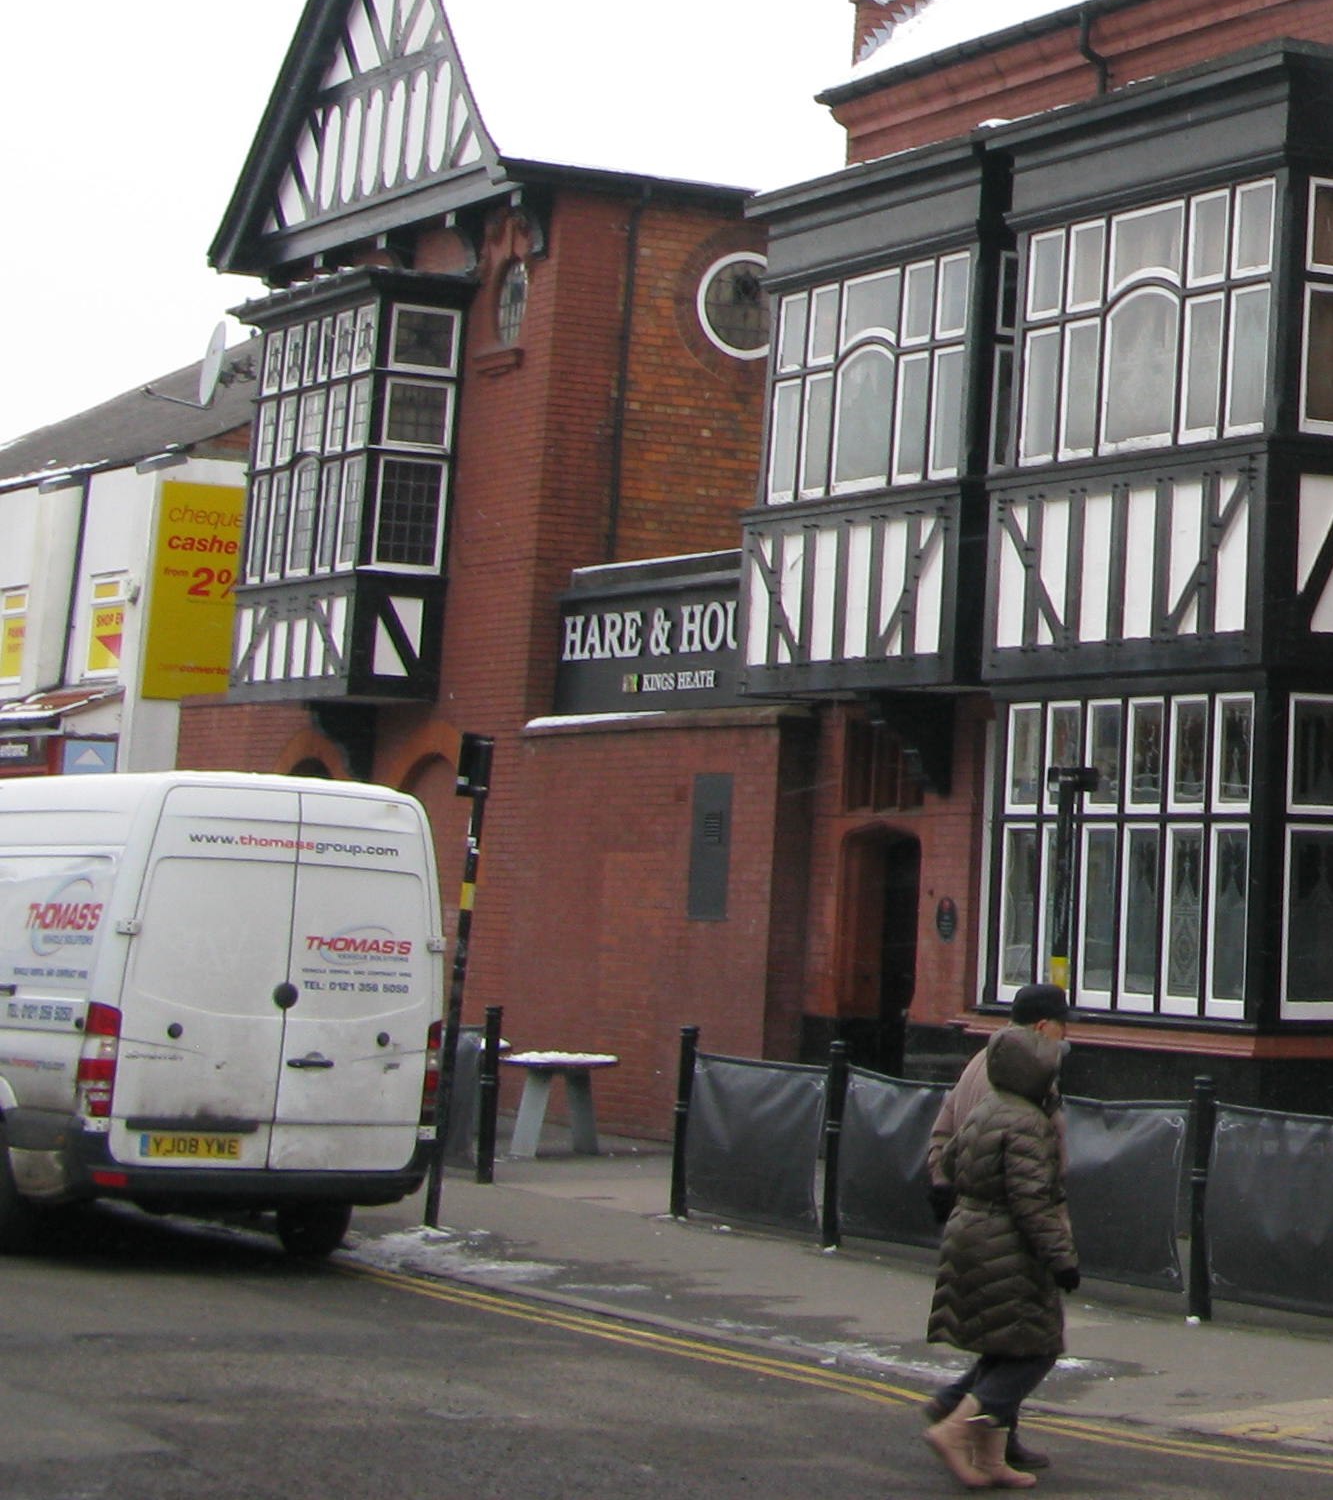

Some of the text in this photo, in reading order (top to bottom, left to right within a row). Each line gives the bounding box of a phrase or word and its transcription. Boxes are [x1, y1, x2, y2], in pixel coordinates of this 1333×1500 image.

[163, 567, 189, 577] from
[562, 610, 642, 661] HARE
[650, 607, 672, 656] &
[642, 670, 715, 692] KINGS HEATH
[189, 832, 399, 857] www.thomassgroup.com
[205, 1138, 239, 1156] YWE
